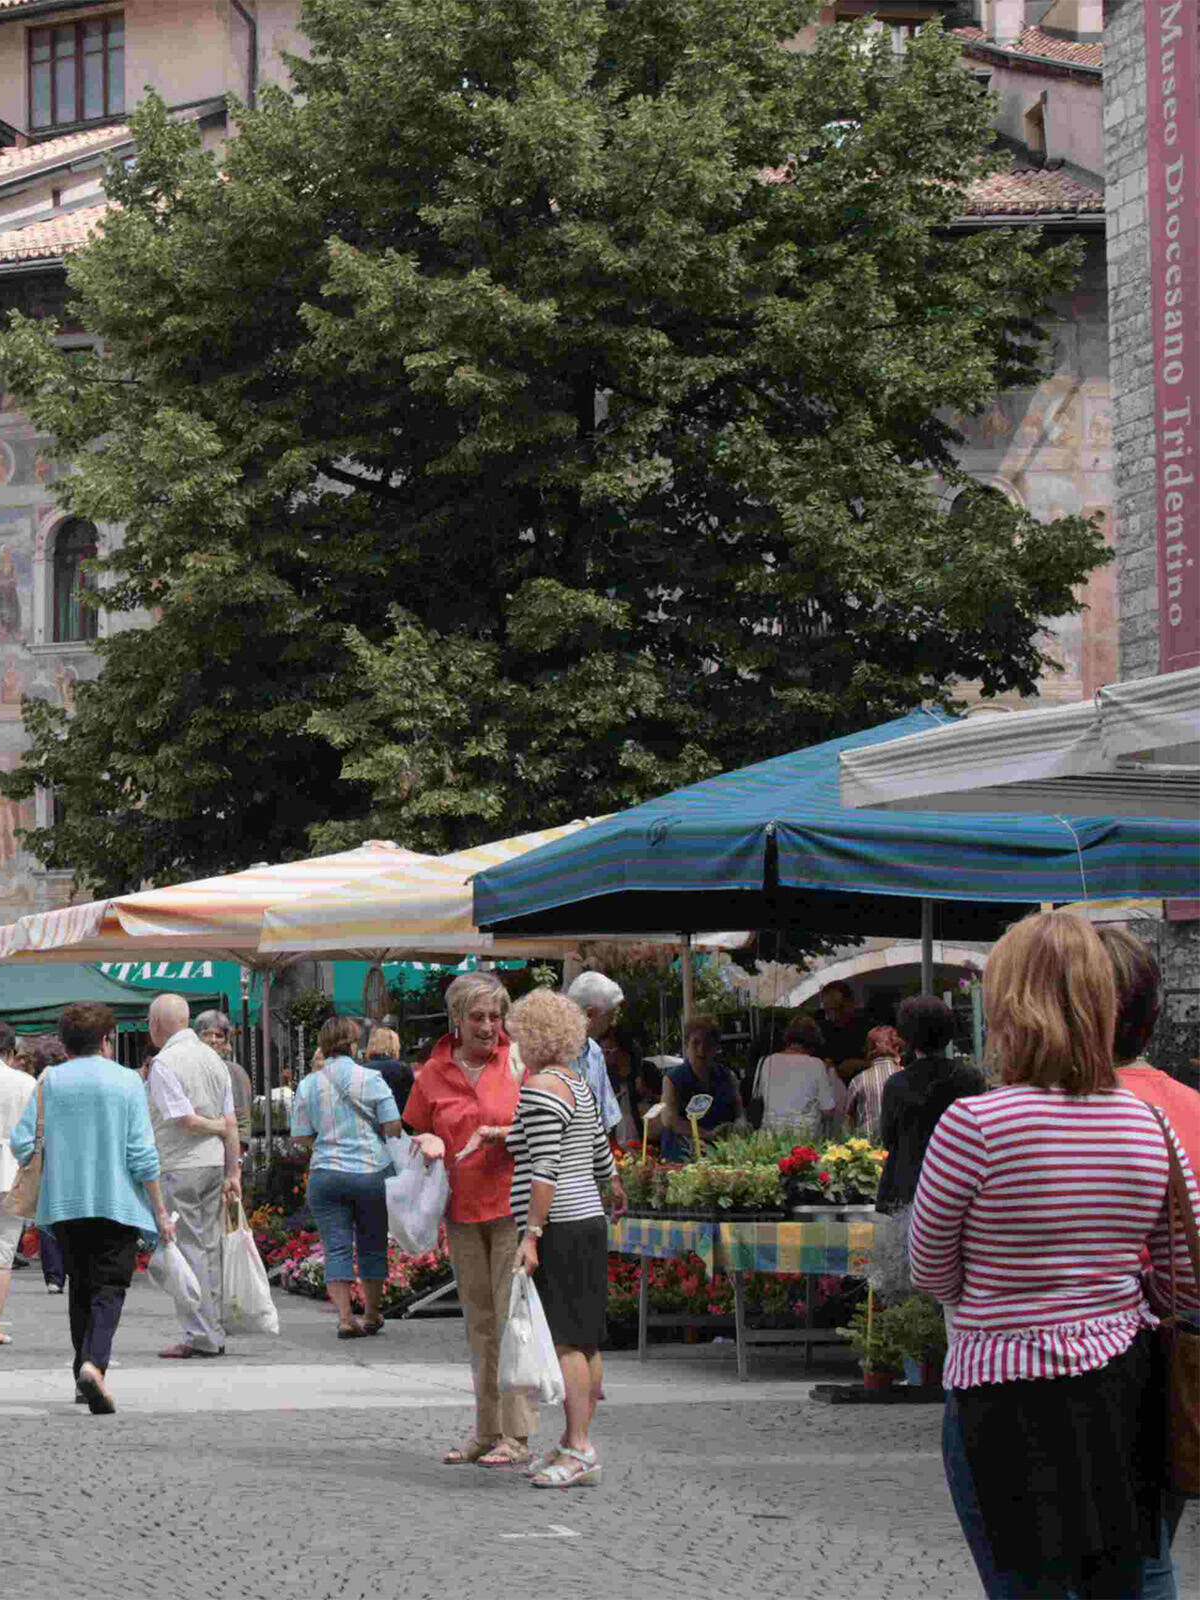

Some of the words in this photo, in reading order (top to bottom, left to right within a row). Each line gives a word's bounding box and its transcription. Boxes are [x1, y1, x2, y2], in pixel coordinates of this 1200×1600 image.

[1160, 0, 1182, 146] Museo
[1163, 154, 1184, 385] Diocesano
[1161, 395, 1194, 627] Tridentino
[100, 960, 213, 981] ITALIA
